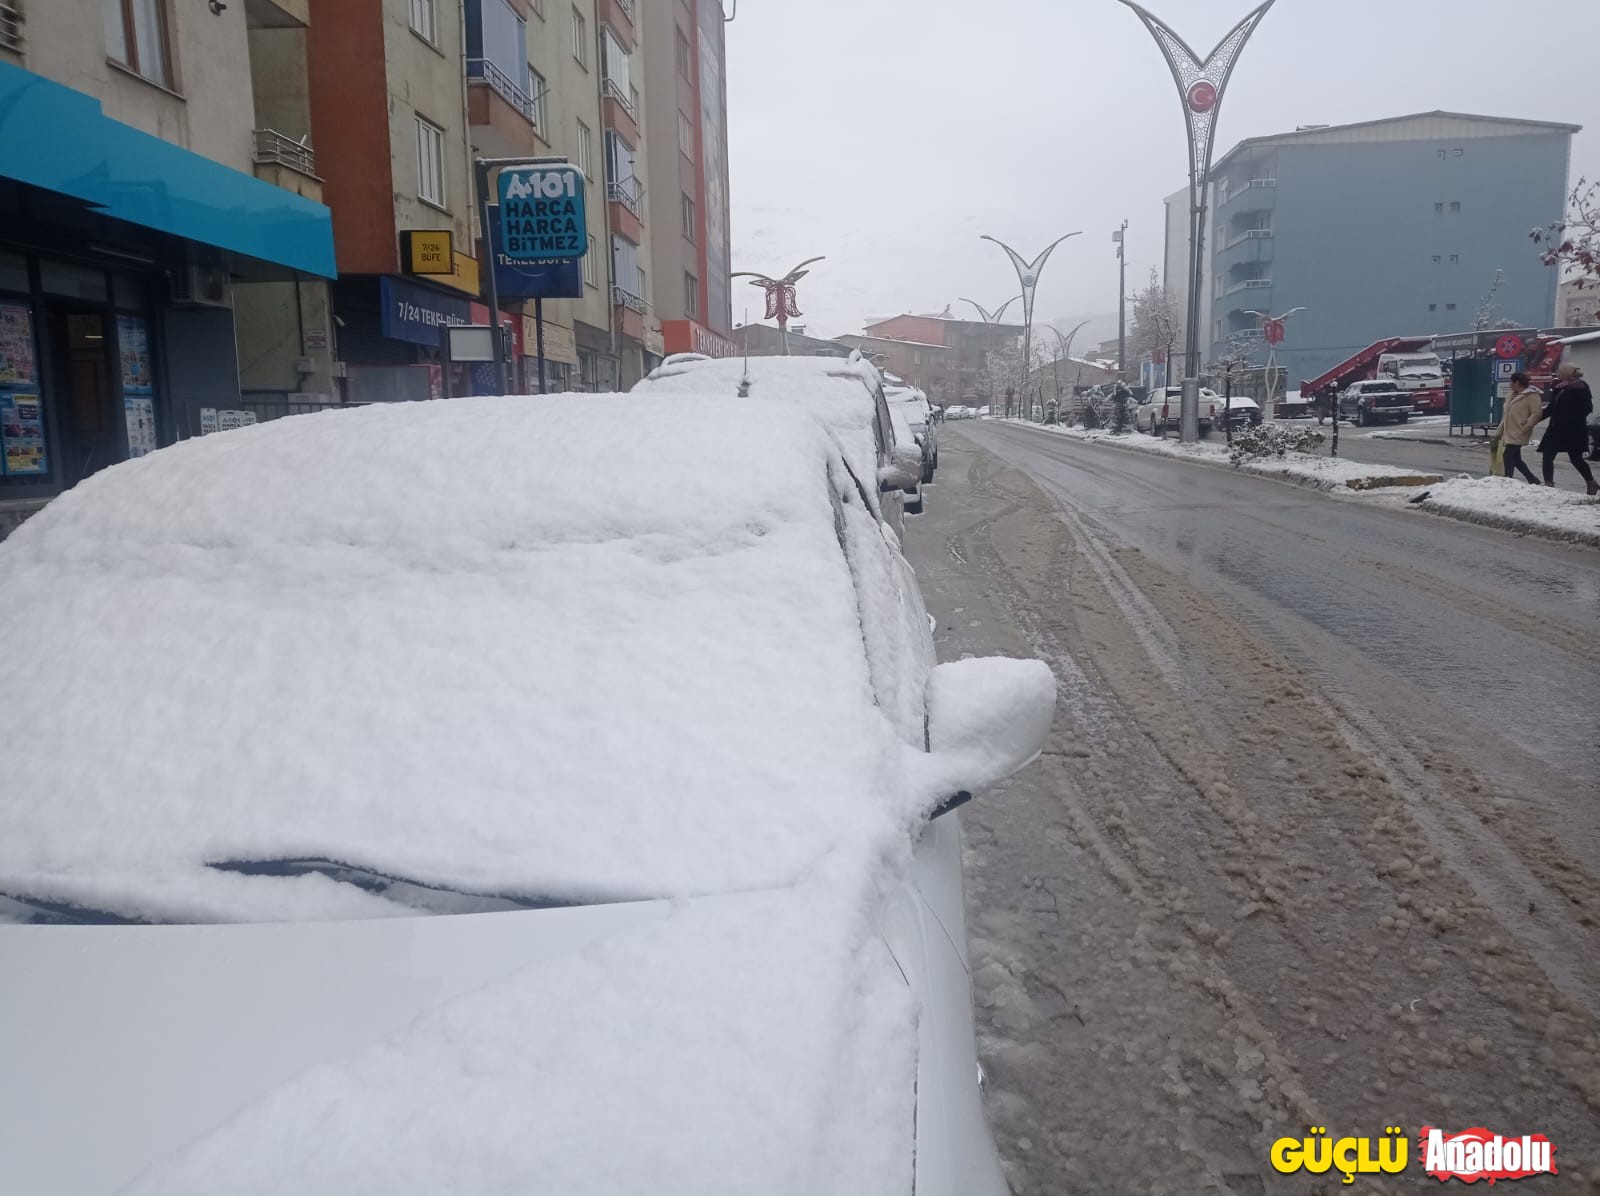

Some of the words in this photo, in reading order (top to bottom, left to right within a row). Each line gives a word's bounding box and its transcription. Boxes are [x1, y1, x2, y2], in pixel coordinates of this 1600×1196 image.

[506, 200, 577, 218] HARCA
[507, 218, 578, 235] HARCA
[421, 243, 440, 252] 7/24
[398, 302, 419, 322] 7/24
[1503, 363, 1512, 373] D
